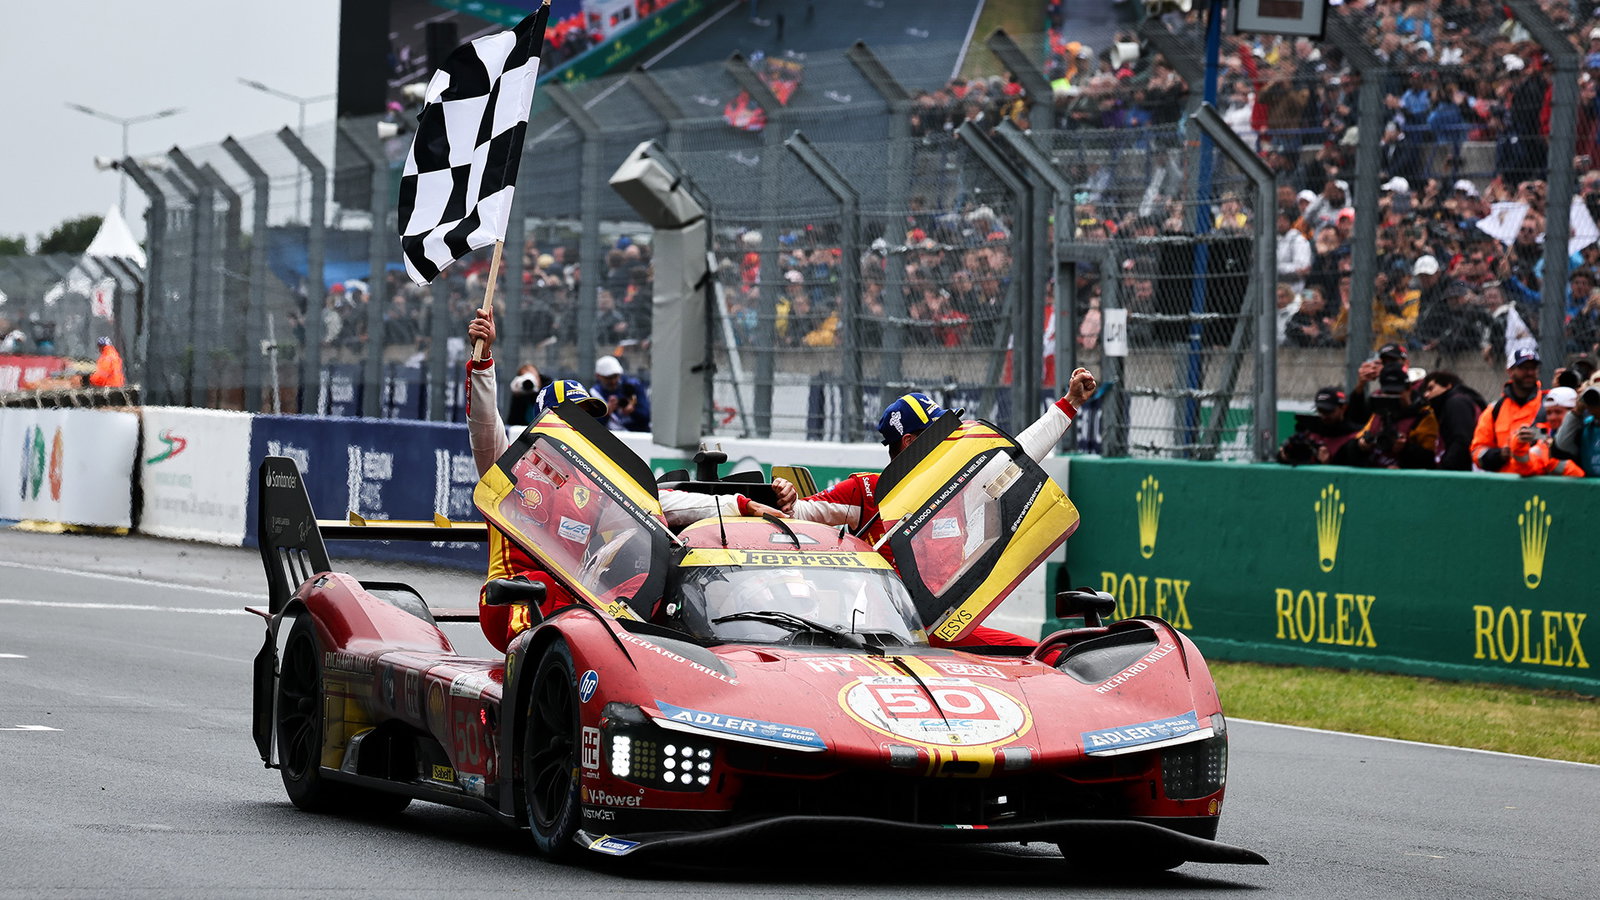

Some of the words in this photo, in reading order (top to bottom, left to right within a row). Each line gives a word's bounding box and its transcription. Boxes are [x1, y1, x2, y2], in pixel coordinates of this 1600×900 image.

[271, 470, 297, 489] Santander
[572, 454, 592, 473] FUOCO
[603, 481, 624, 502] MOLINA
[913, 508, 932, 526] FUOCO
[940, 482, 960, 501] MOLINA
[966, 454, 988, 474] NIELSEN
[740, 550, 866, 567] Ferrari
[1100, 571, 1193, 630] ROLEX
[1275, 588, 1378, 648] ROLEX
[1473, 604, 1590, 669] ROLEX
[324, 652, 354, 669] RICHARD
[354, 655, 375, 671] MILLE
[616, 631, 687, 664] RICHARD
[689, 658, 741, 686] MILLE
[1094, 660, 1149, 695] RICHARD
[1145, 641, 1178, 665] MILLE
[580, 670, 597, 702] hp
[874, 687, 987, 715] 50
[671, 710, 758, 733] ADLER
[1089, 726, 1158, 747] ADLER
[454, 710, 480, 766] 50
[781, 732, 814, 742] GROUP
[434, 766, 452, 781] Sabelt
[588, 788, 643, 807] V-Power
